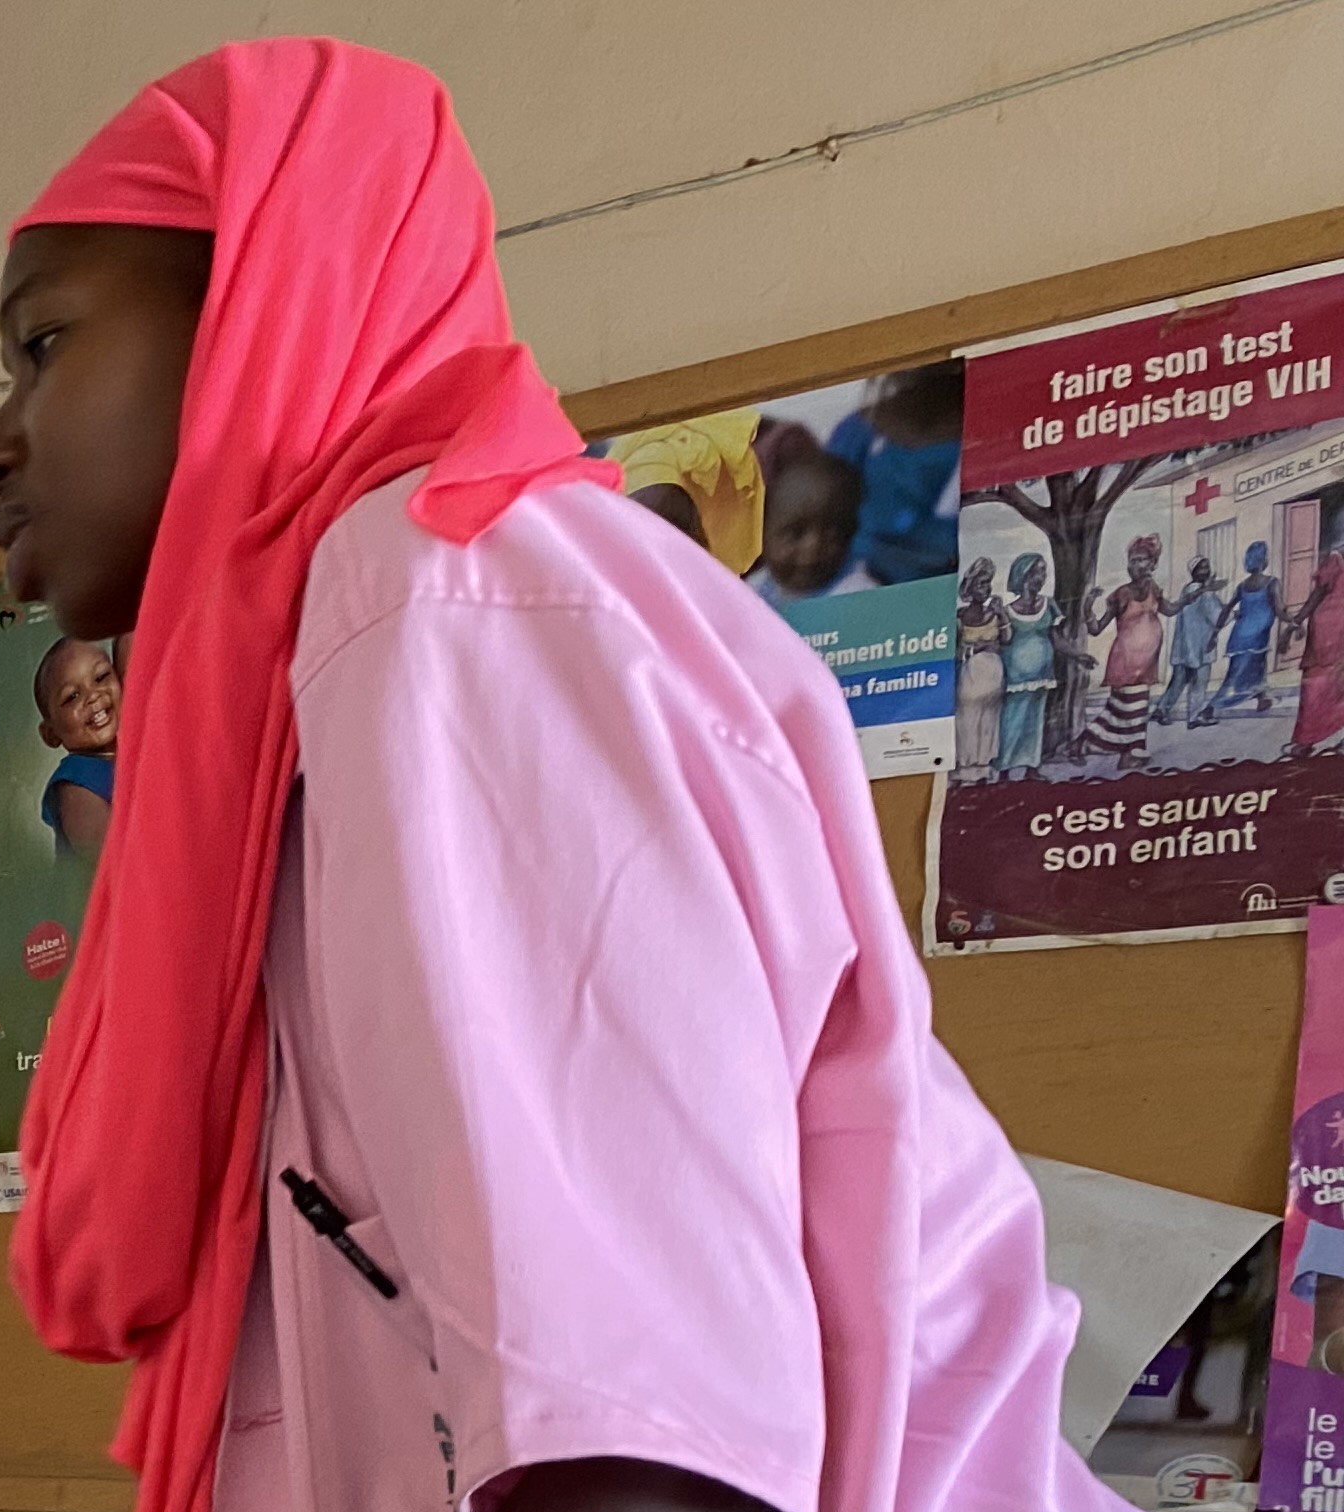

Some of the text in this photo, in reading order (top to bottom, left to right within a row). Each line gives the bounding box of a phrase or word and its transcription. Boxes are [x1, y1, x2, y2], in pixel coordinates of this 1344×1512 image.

[1050, 320, 1294, 403] faire son test
[1023, 354, 1332, 450] de dépistage VIH
[1238, 461, 1295, 495] CENTRE
[1298, 458, 1314, 472] DE
[818, 626, 948, 667] ement iodé
[867, 670, 938, 696] famille
[1030, 788, 1278, 837] c'est sauver
[1042, 820, 1258, 872] son enfant
[1308, 1407, 1338, 1433] le
[1306, 1434, 1336, 1460] le
